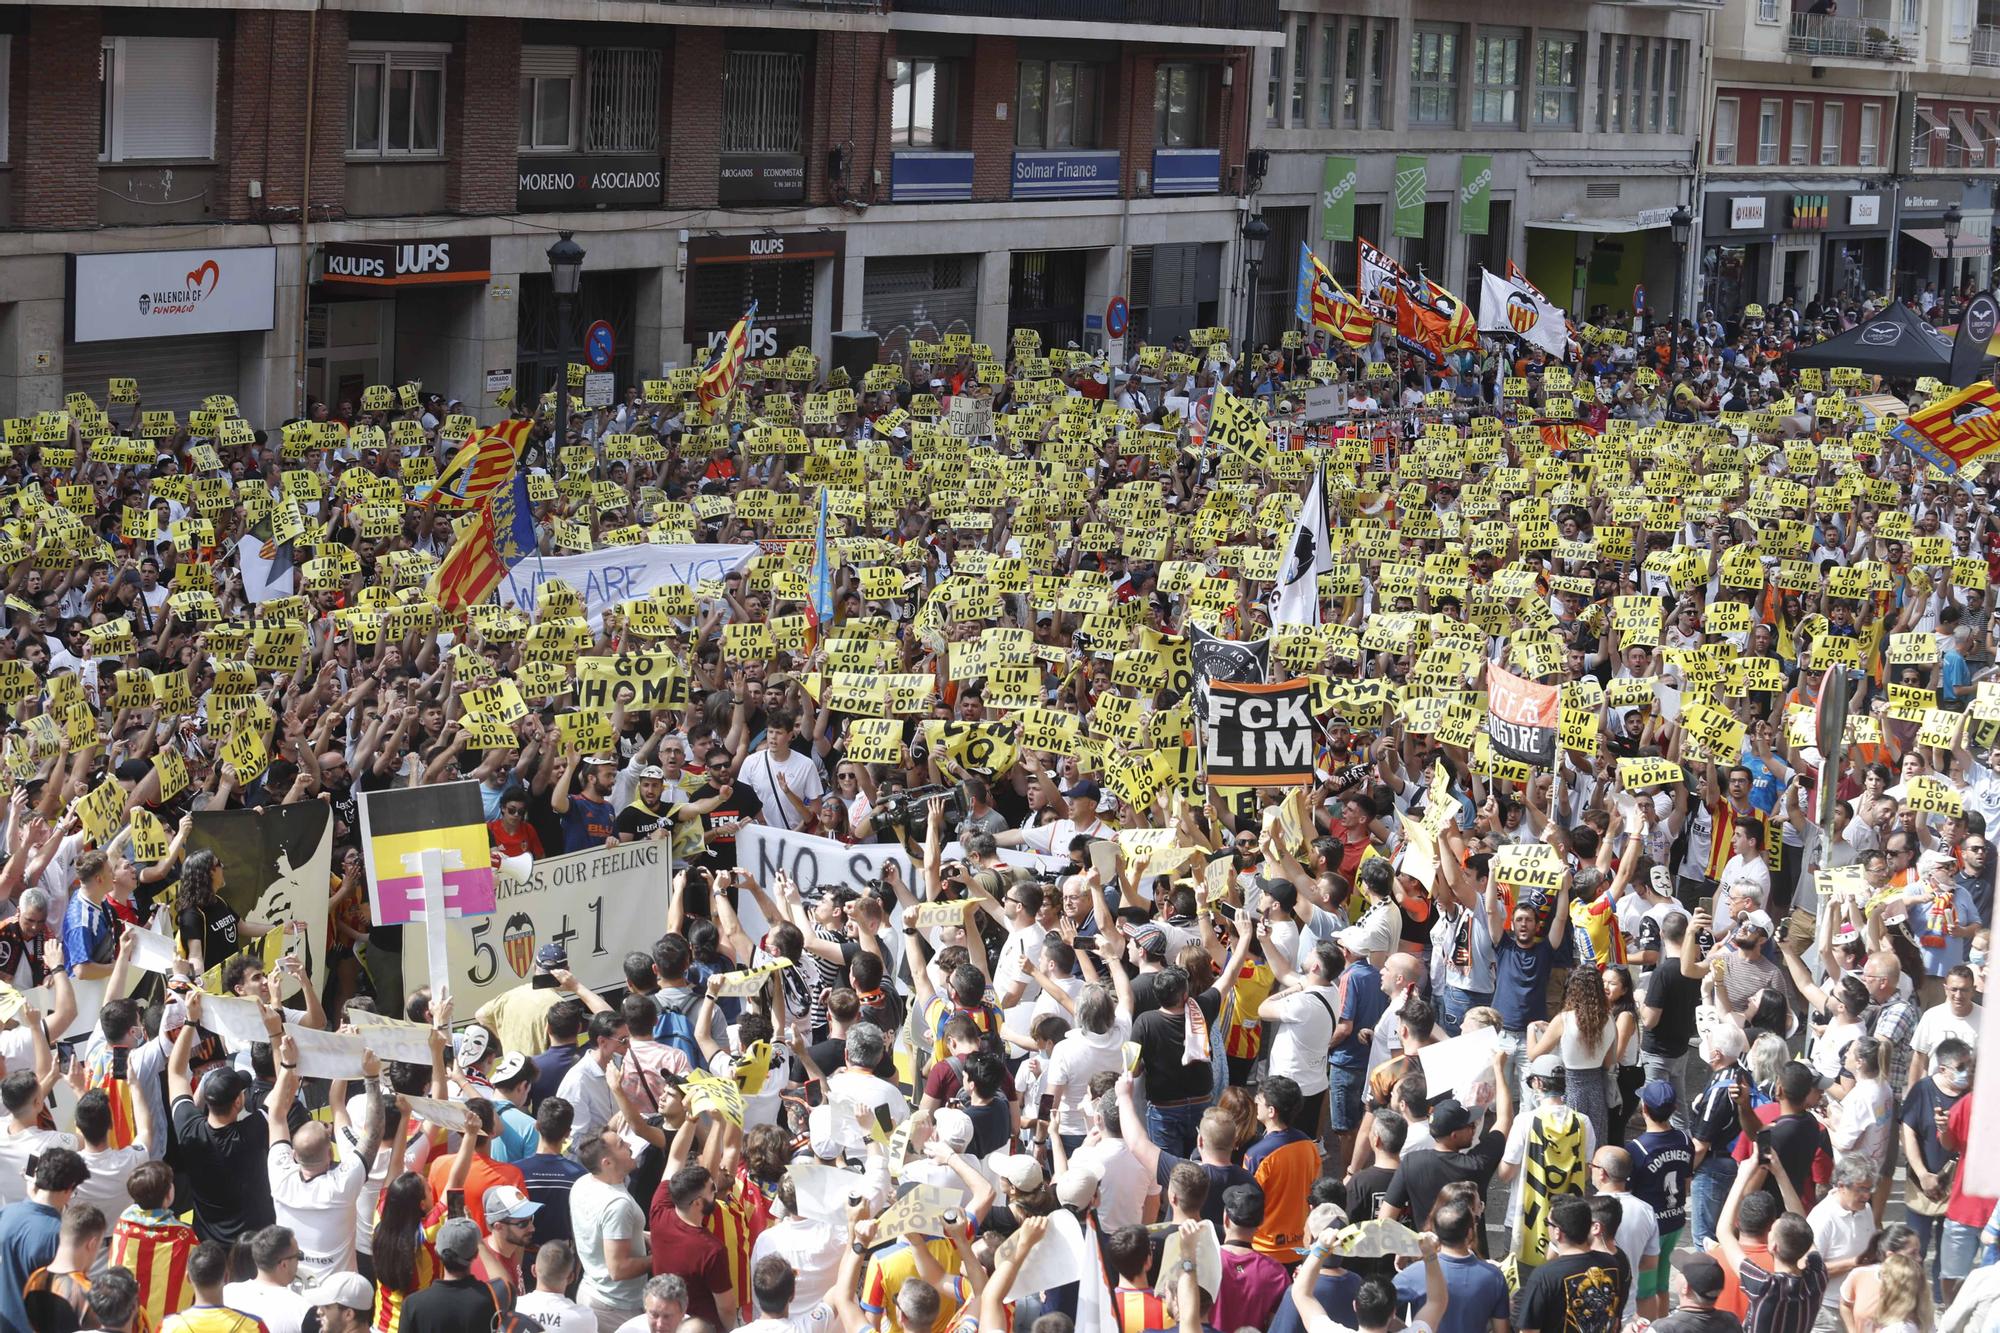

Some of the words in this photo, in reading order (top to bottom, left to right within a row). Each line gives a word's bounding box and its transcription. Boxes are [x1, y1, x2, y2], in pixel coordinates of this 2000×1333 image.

[722, 168, 754, 178] ABOGADOS
[764, 168, 803, 177] ECONOMISTAS
[1016, 162, 1054, 179] Solmar
[1057, 162, 1097, 178] Finance
[520, 174, 574, 190] MORENO
[592, 172, 660, 188] ASOCIADOS
[1461, 168, 1491, 204] Resa
[1324, 171, 1356, 208] Resa
[1742, 206, 1762, 220] YAMAHA
[750, 239, 784, 254] KUUPS
[396, 243, 450, 273] UUPS
[329, 256, 384, 277] KUUPS
[152, 290, 191, 304] VALENCIA
[193, 290, 202, 301] CF
[708, 328, 778, 358] KPS
[370, 387, 388, 395] LIM
[954, 398, 962, 408] EL
[150, 412, 169, 422] LIM
[225, 421, 243, 430] LIM
[145, 427, 174, 436] HOME
[223, 434, 253, 444] HOME
[1208, 419, 1266, 464] HOME
[1340, 439, 1369, 447] HOME
[1343, 453, 1364, 462] LIM
[974, 480, 996, 489] LIM
[979, 489, 991, 498] GO
[1823, 488, 1843, 497] LIM
[969, 497, 1002, 506] HOME
[367, 508, 389, 517] LIM
[782, 508, 805, 517] LIM
[1409, 511, 1432, 520] LIM
[375, 517, 387, 525] GO
[788, 517, 800, 525] GO
[364, 525, 399, 536] HOME
[776, 526, 813, 535] HOME
[1086, 524, 1108, 533] LIM
[1402, 527, 1439, 538] HOME
[1602, 528, 1625, 536] LIM
[1080, 541, 1116, 550] HOME
[1920, 539, 1943, 547] LIM
[1599, 544, 1631, 555] HOME
[1926, 548, 1938, 556] GO
[1914, 556, 1950, 565] HOME
[1954, 557, 1986, 571] HOME
[1961, 568, 1974, 576] GO
[585, 564, 650, 602] ARE
[1955, 575, 1978, 587] LIM
[1623, 598, 1651, 608] LIM
[1630, 609, 1644, 617] GO
[1616, 618, 1659, 628] HOME
[732, 626, 761, 637] LIM
[264, 634, 294, 646] LIM
[740, 638, 756, 646] GO
[1899, 634, 1926, 644] LIM
[269, 646, 285, 654] GO
[1905, 644, 1919, 652] GO
[255, 654, 298, 668] HOME
[1230, 650, 1245, 664] HO
[1892, 652, 1937, 662] HOME
[526, 662, 554, 674] LIM
[614, 657, 654, 676] GO
[534, 673, 550, 682] GO
[995, 670, 1027, 682] LIM
[526, 682, 568, 696] HOME
[585, 676, 687, 710] HOME
[1004, 683, 1021, 693] GO
[989, 696, 1038, 707] HOME
[1208, 692, 1311, 728] FCK
[481, 724, 495, 732] GO
[858, 722, 890, 734] LIM
[470, 734, 514, 746] HOME
[864, 736, 881, 746] GO
[1206, 728, 1312, 767] LIM
[850, 749, 897, 761] HOME
[1631, 757, 1663, 765] LIM
[1627, 769, 1679, 785] HOME
[1918, 781, 1947, 792] LIM
[1926, 791, 1941, 800] GO
[1911, 800, 1959, 815] HOME
[710, 816, 739, 828] FCK
[1512, 846, 1550, 858] LIM
[553, 861, 586, 887] OUR
[591, 844, 660, 877] FEELING
[758, 837, 818, 898] NO
[1520, 858, 1539, 867] GO
[1498, 867, 1559, 885] HOME
[211, 913, 236, 932] LIBERTA
[1647, 1150, 1690, 1174] DOMENECH
[1664, 1170, 1678, 1208] 1
